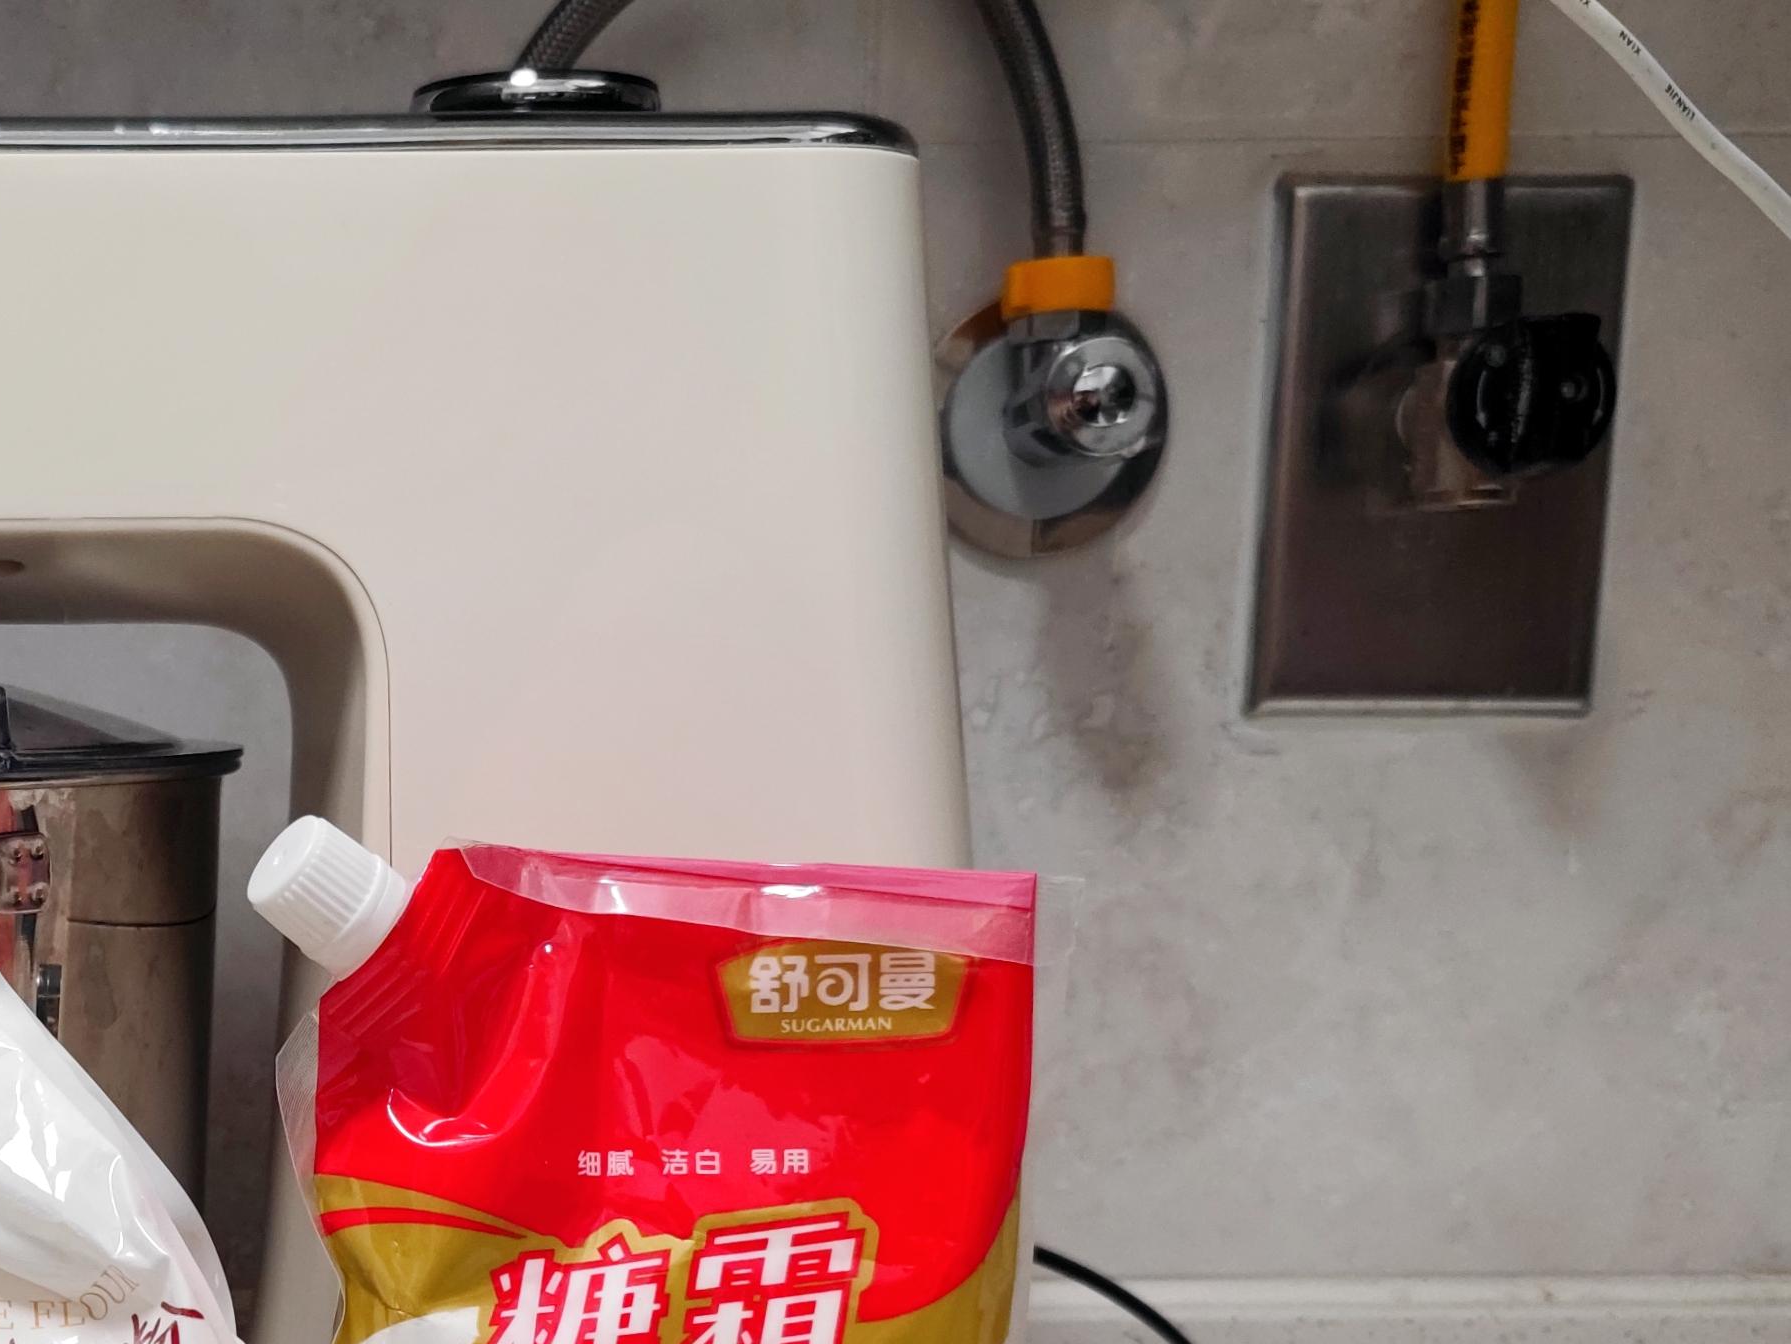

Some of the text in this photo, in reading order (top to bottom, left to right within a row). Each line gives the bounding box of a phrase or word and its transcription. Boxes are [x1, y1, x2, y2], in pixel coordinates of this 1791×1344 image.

[1619, 30, 1642, 56] XIAN
[748, 952, 936, 1014] 舒可曼
[780, 1017, 893, 1034] SUGARMAN
[577, 1148, 811, 1177] 细腻 洁白 易用
